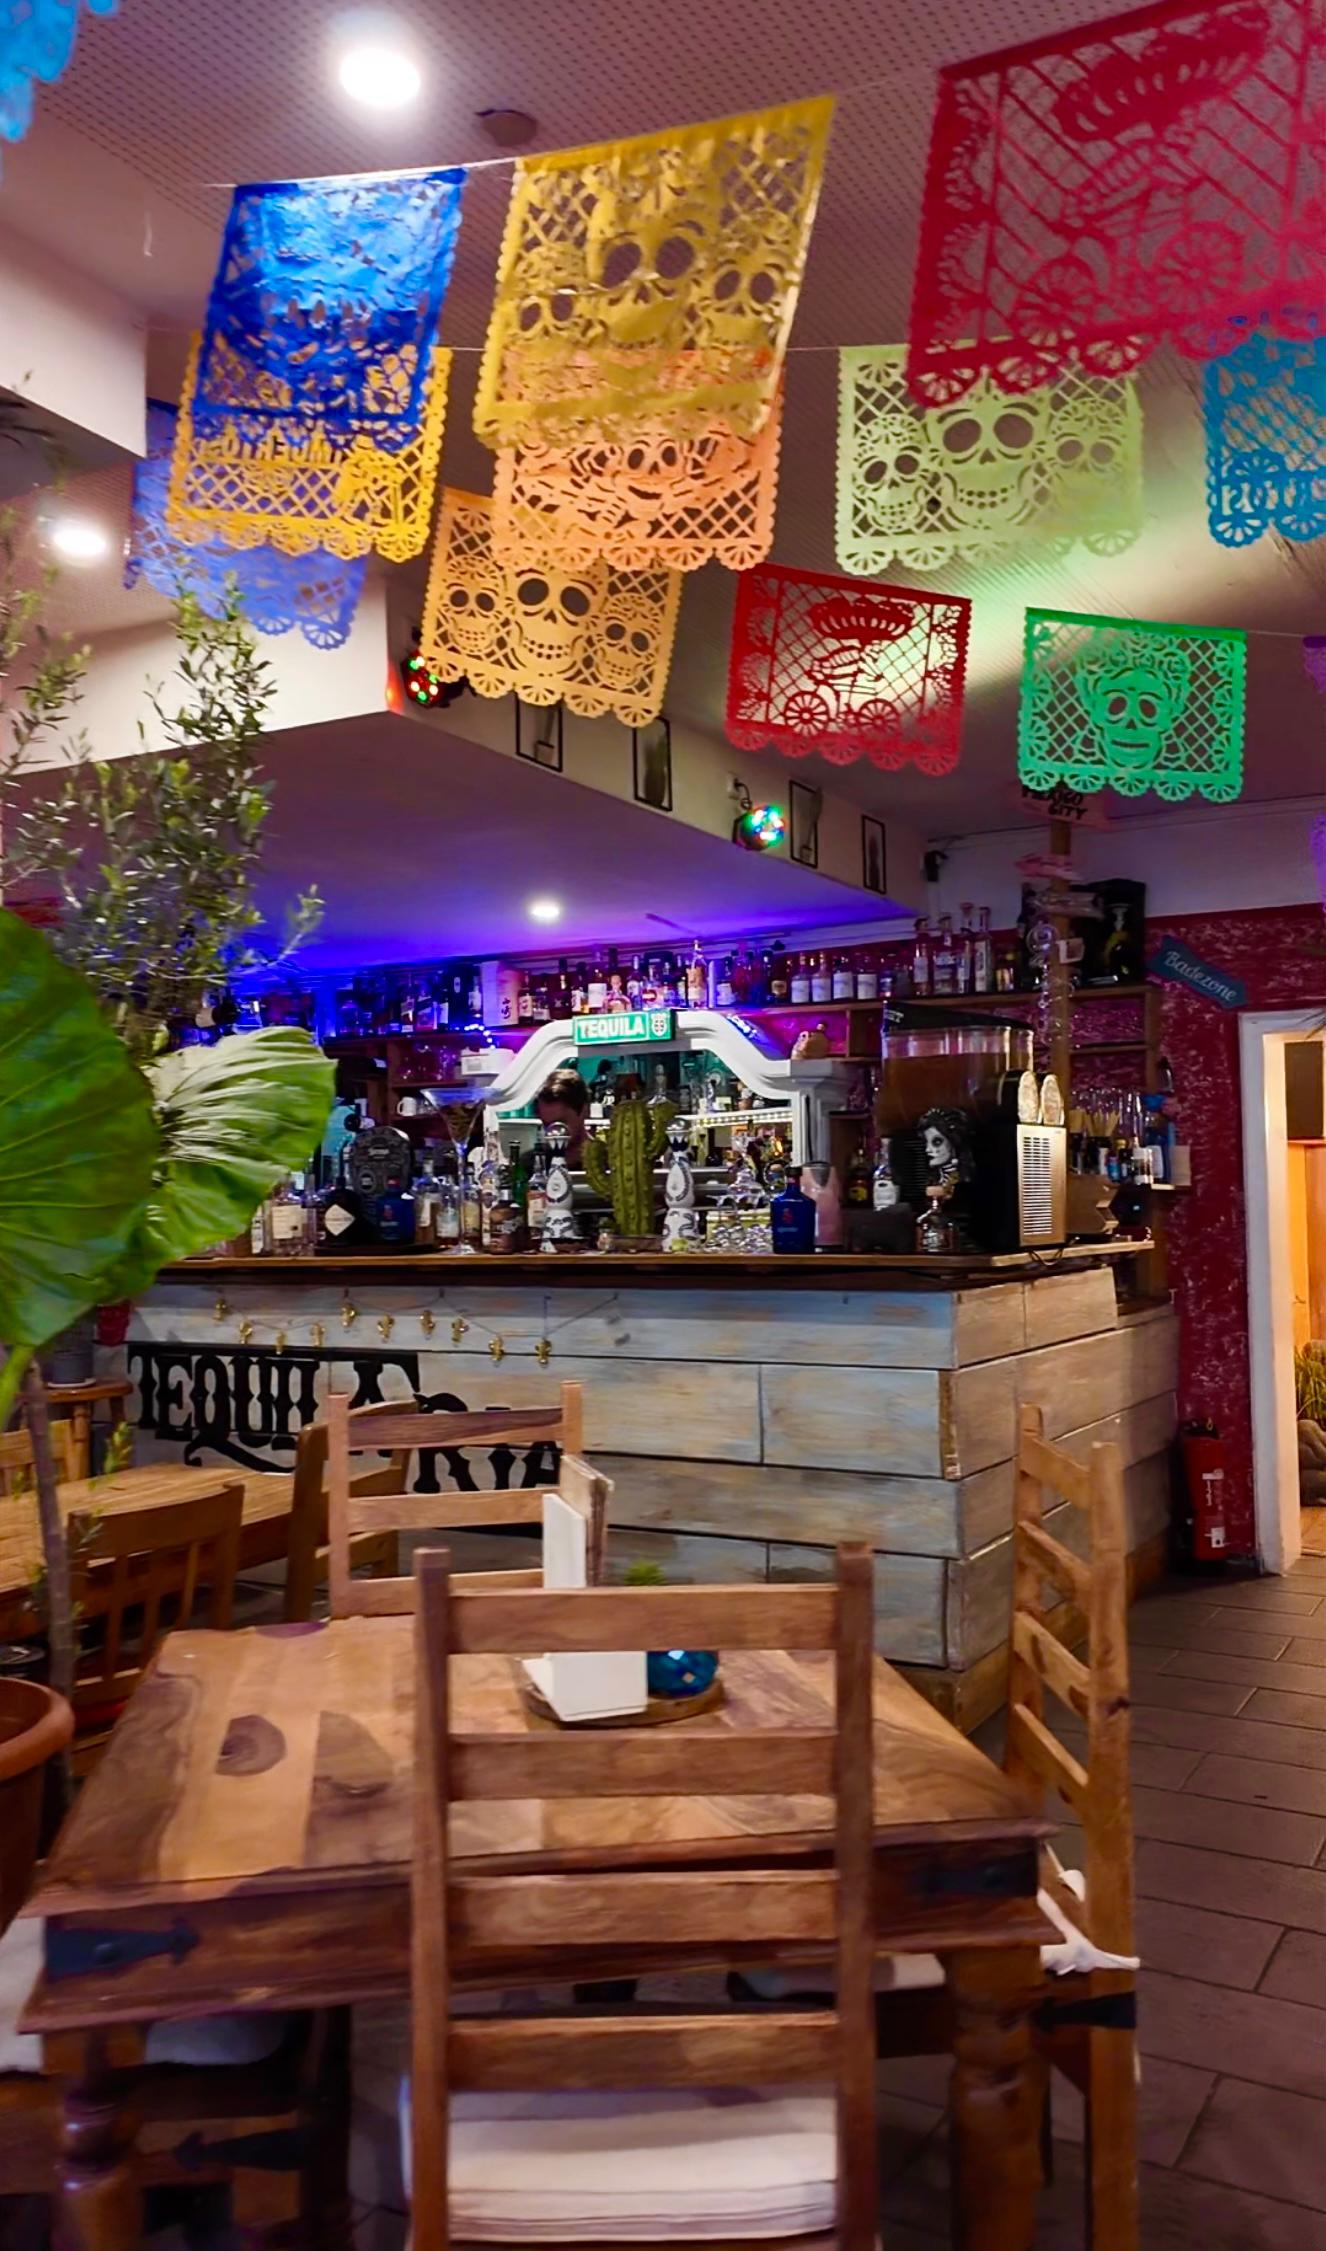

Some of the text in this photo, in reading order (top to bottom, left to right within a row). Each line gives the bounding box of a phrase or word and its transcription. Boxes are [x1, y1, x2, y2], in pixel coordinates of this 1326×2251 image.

[1048, 801, 1087, 820] CITY
[1164, 950, 1237, 1001] Badezone
[578, 1015, 645, 1039] TEQUILA
